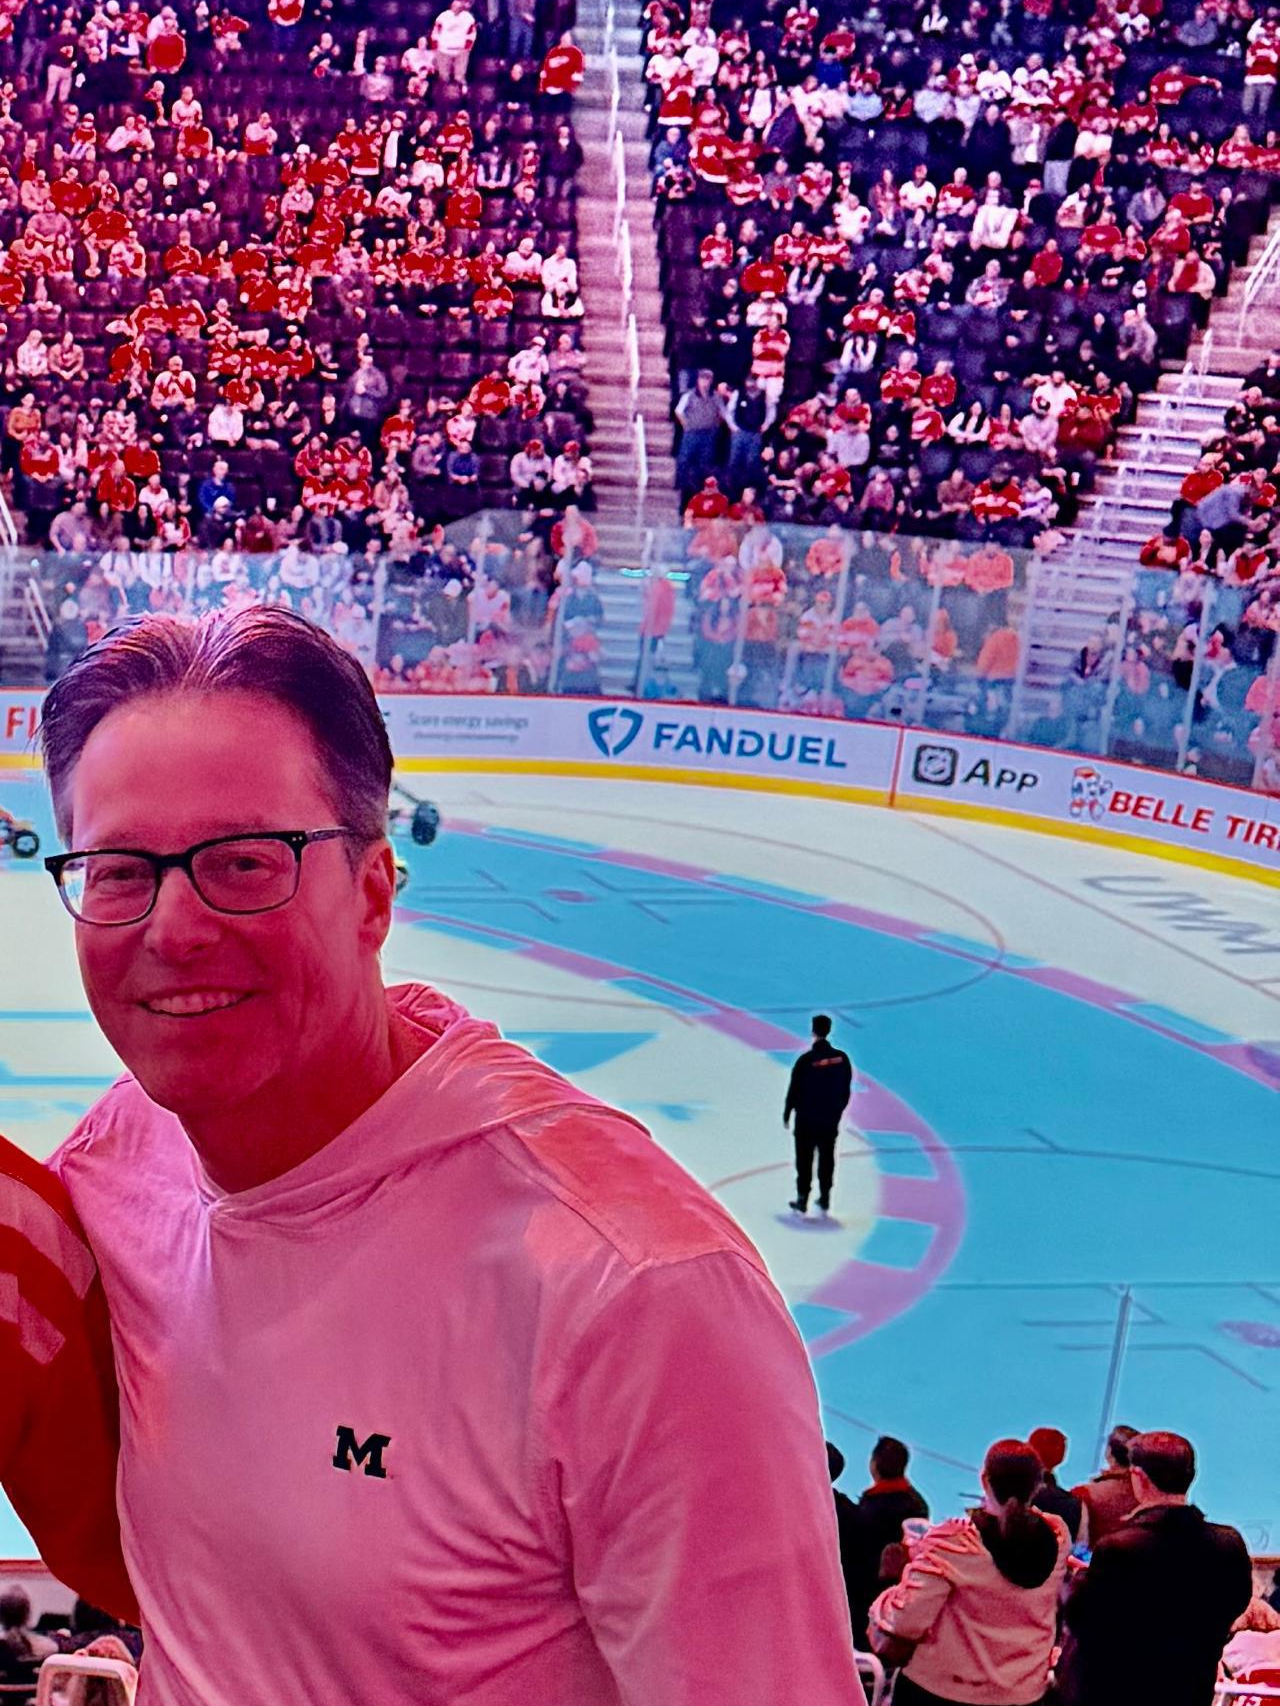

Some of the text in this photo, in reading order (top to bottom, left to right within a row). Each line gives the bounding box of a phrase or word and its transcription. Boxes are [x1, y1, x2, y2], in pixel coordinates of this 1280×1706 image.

[652, 722, 848, 769] FANDUEL
[962, 758, 1040, 793] App
[1107, 790, 1280, 853] BELLE TIR
[332, 1424, 392, 1479] M
